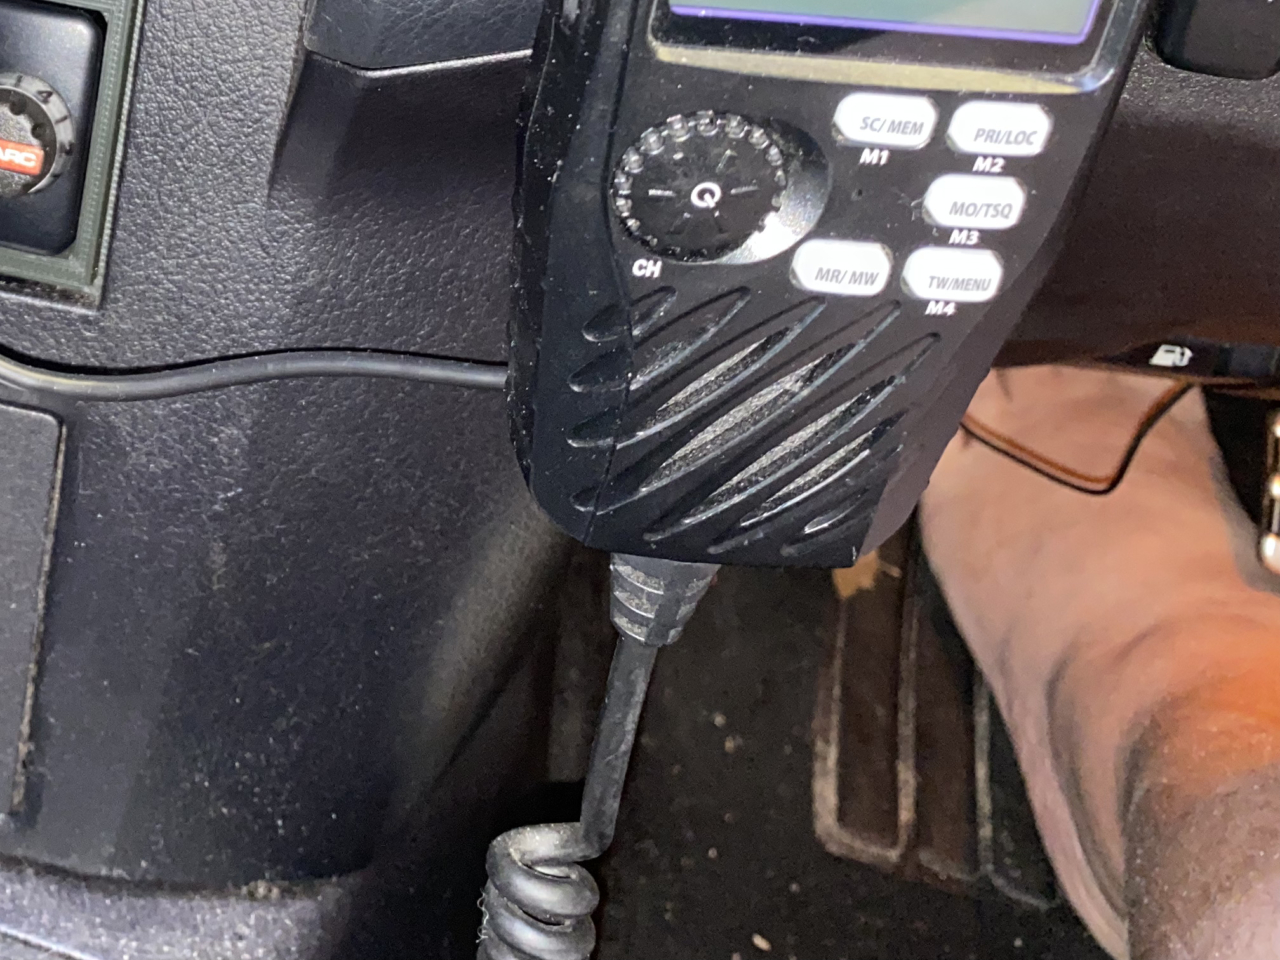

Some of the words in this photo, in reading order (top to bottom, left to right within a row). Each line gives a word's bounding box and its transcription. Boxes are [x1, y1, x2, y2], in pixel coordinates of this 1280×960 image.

[973, 128, 1038, 146] PRI/LOC
[859, 148, 890, 166] M1
[972, 156, 1006, 173] M2
[949, 201, 1013, 219] MO/TSQ
[948, 229, 981, 246] M3
[632, 258, 663, 279] CH
[928, 275, 992, 292] TW/MENU
[925, 300, 957, 317] M4
